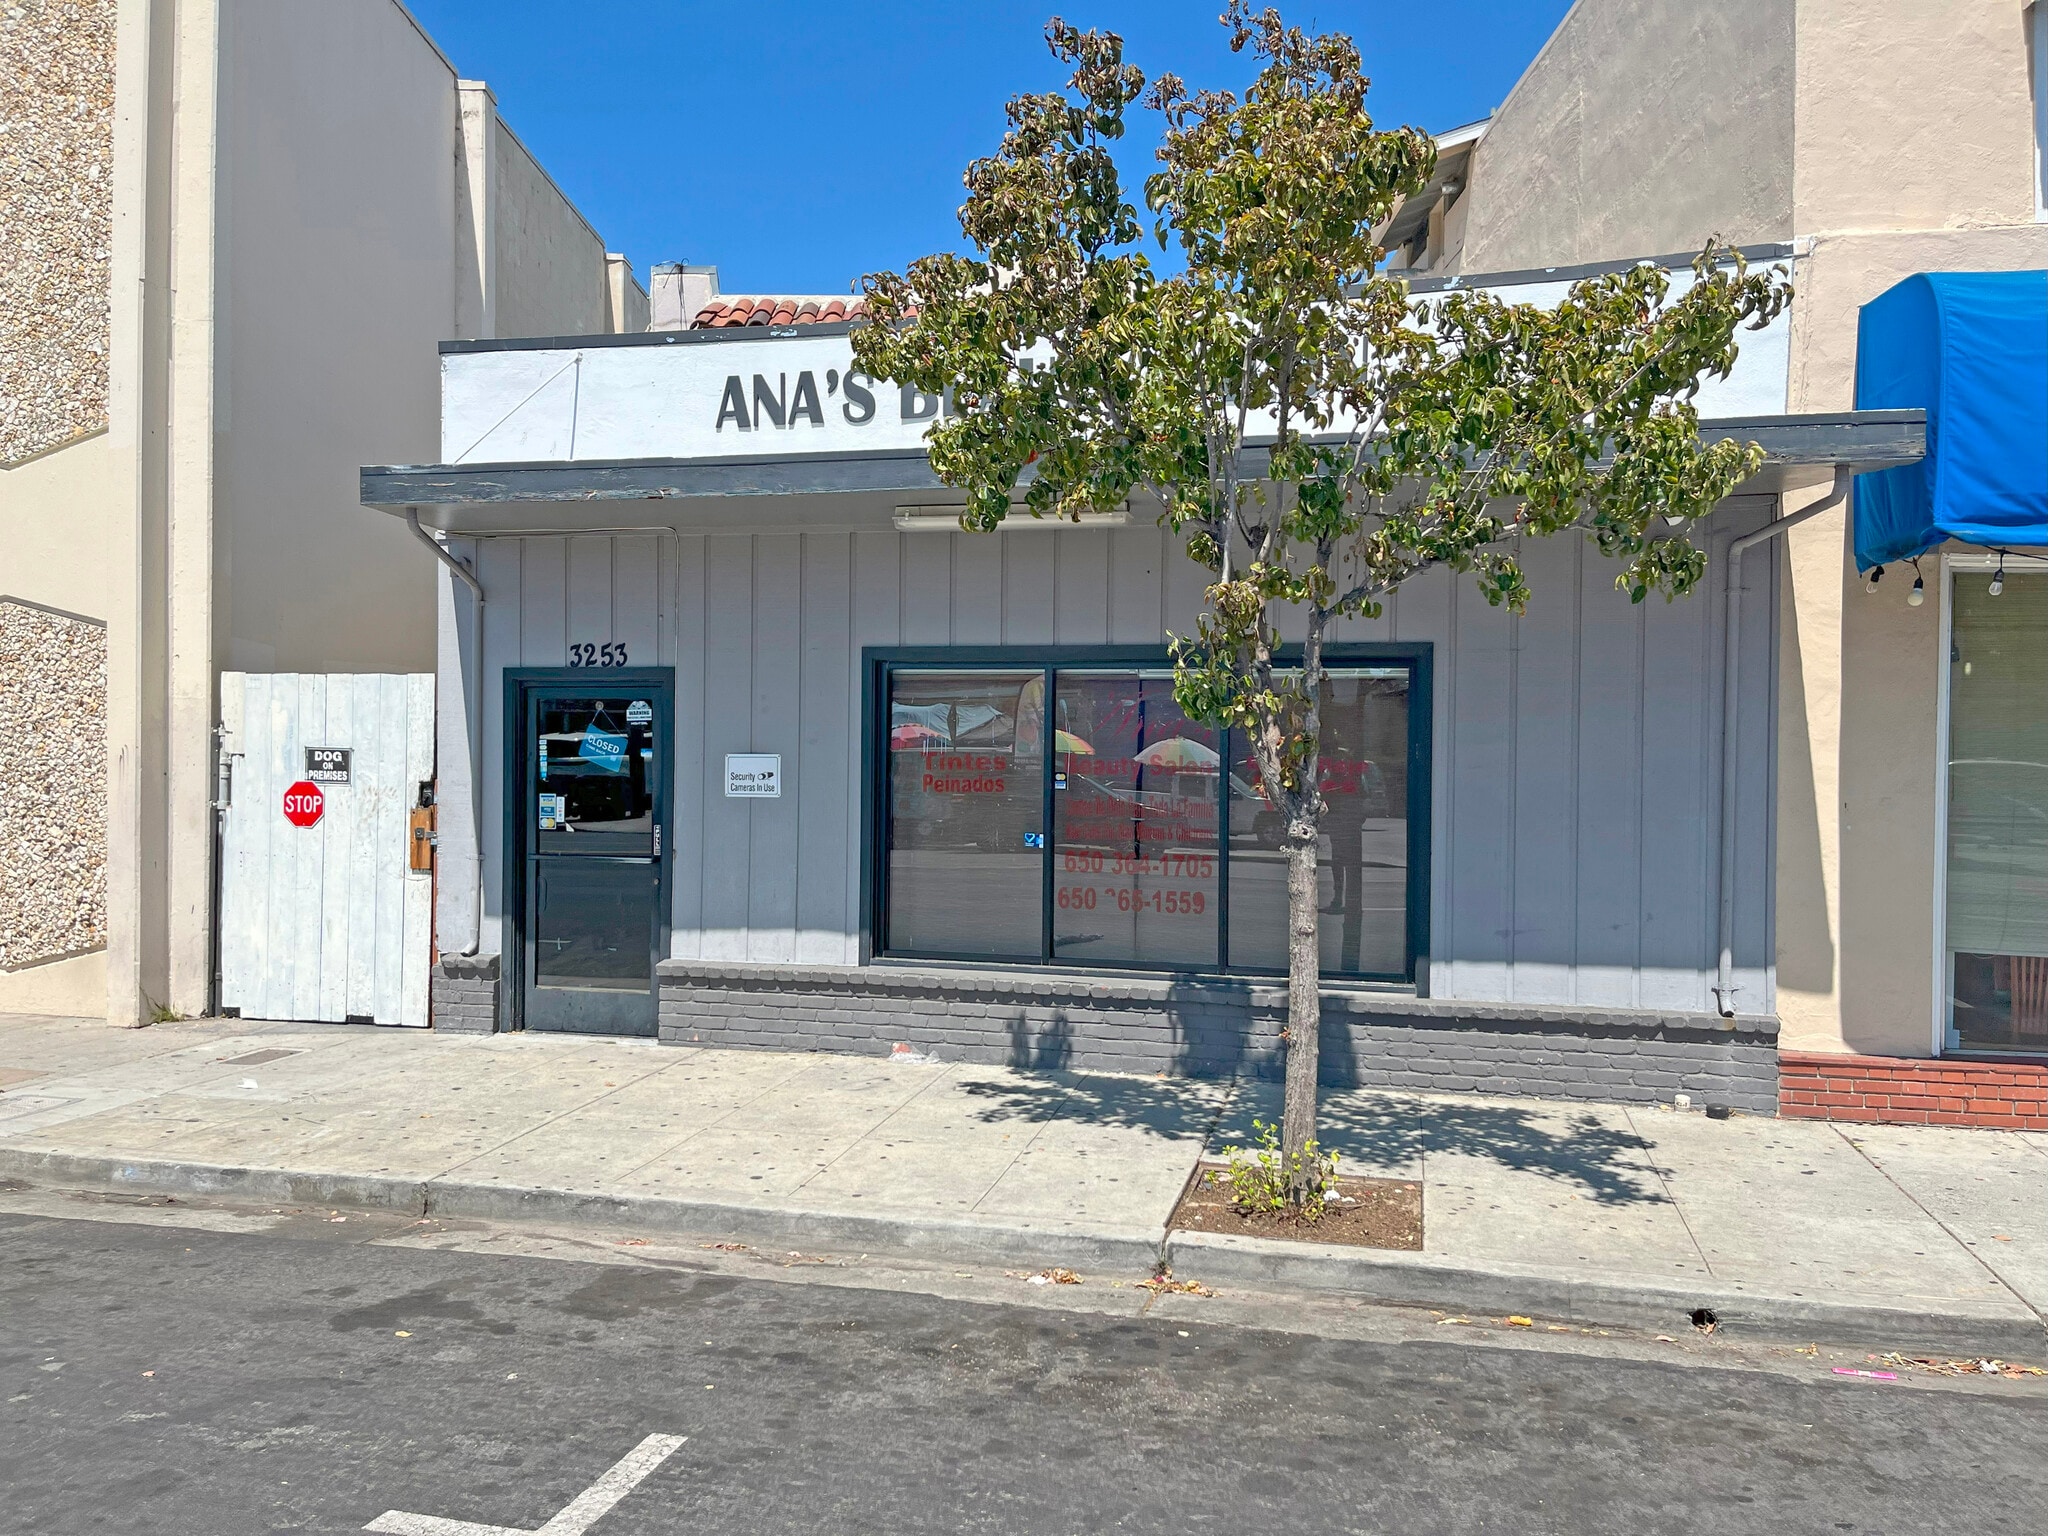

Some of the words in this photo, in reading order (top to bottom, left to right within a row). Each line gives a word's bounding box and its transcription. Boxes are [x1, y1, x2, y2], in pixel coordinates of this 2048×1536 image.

[716, 368, 876, 431] ANA'S
[570, 642, 628, 668] 3253
[588, 735, 620, 754] CLOSED
[314, 751, 342, 762] DOG
[322, 762, 334, 770] ON
[923, 752, 1007, 771] Tintes
[308, 770, 348, 781] PREMISES
[1064, 752, 1142, 782] Beauty
[1149, 753, 1214, 776] Salon
[730, 771, 756, 783] Security
[922, 773, 1005, 793] Peinados
[730, 783, 756, 792] Cameras
[757, 783, 763, 792] In
[763, 783, 775, 792] Use
[285, 795, 322, 813] STOP
[1064, 850, 1104, 874] 650
[1111, 851, 1214, 879] 364-1705
[1057, 886, 1097, 911] 650
[1104, 887, 1206, 915] 65-1559
